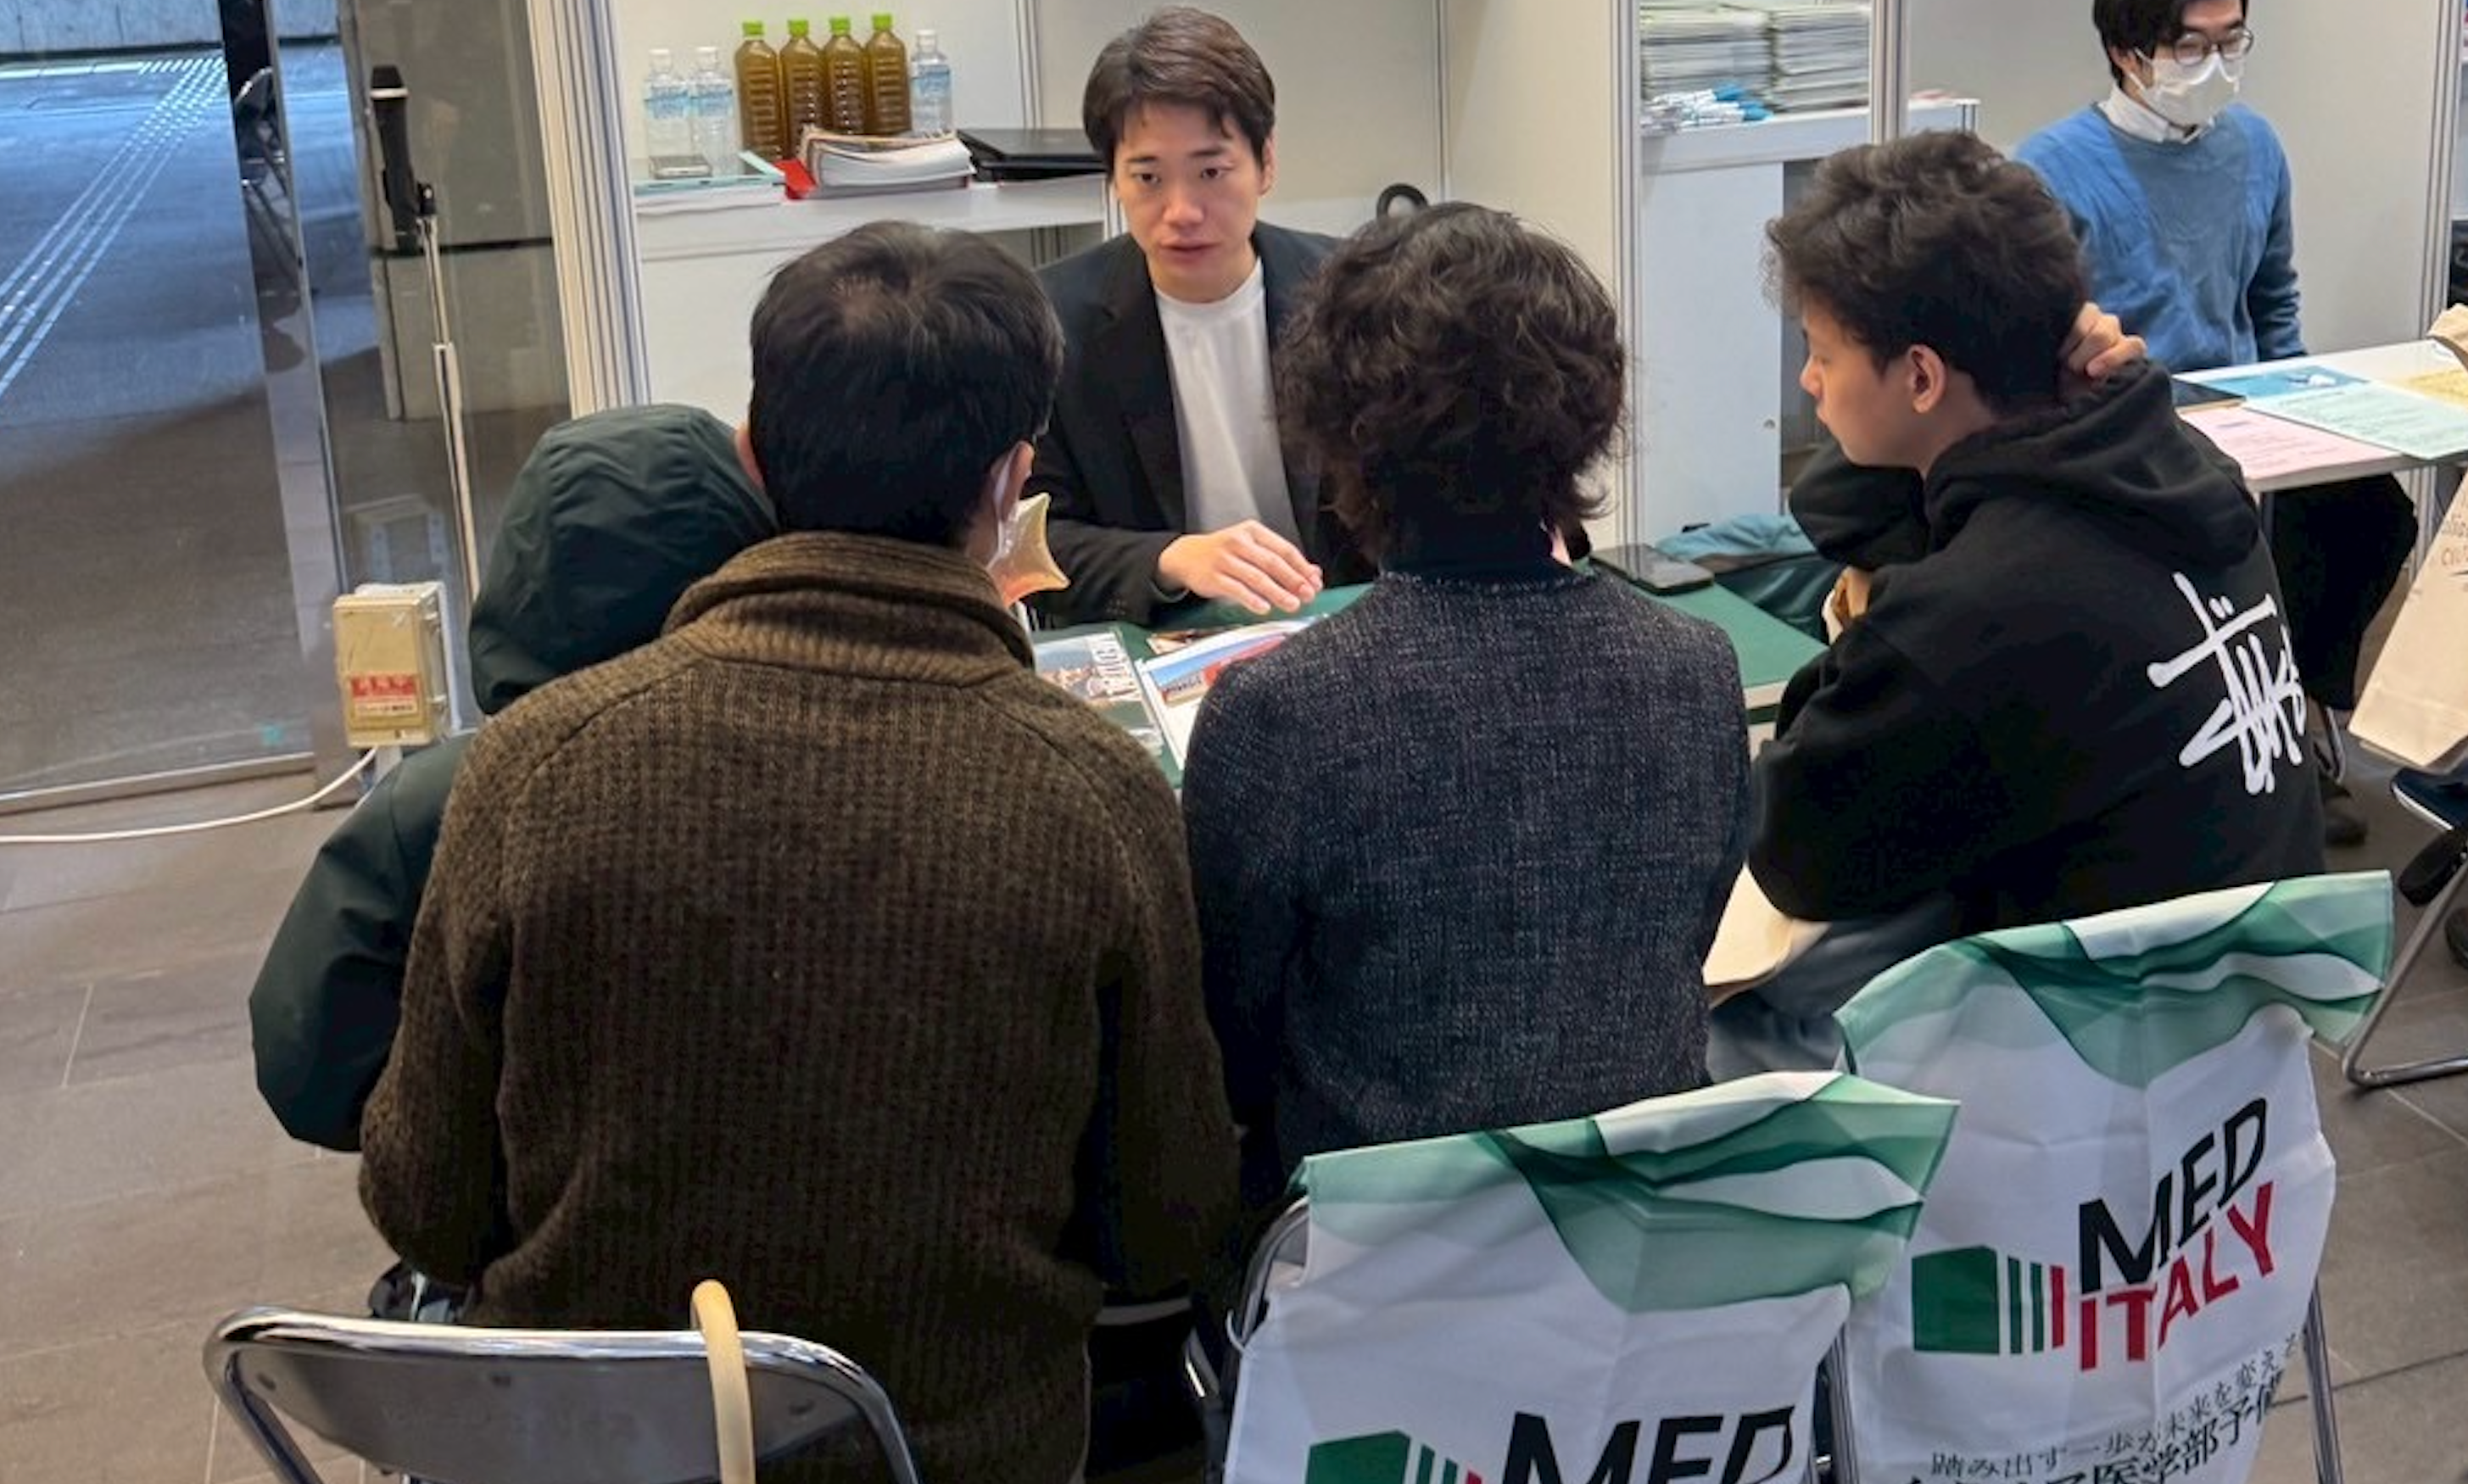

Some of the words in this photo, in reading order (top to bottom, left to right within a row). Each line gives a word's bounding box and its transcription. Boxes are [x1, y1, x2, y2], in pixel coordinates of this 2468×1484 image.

[2078, 1097, 2267, 1294] MED
[2080, 1180, 2274, 1371] ITALY
[1501, 1405, 1796, 1484] MED
